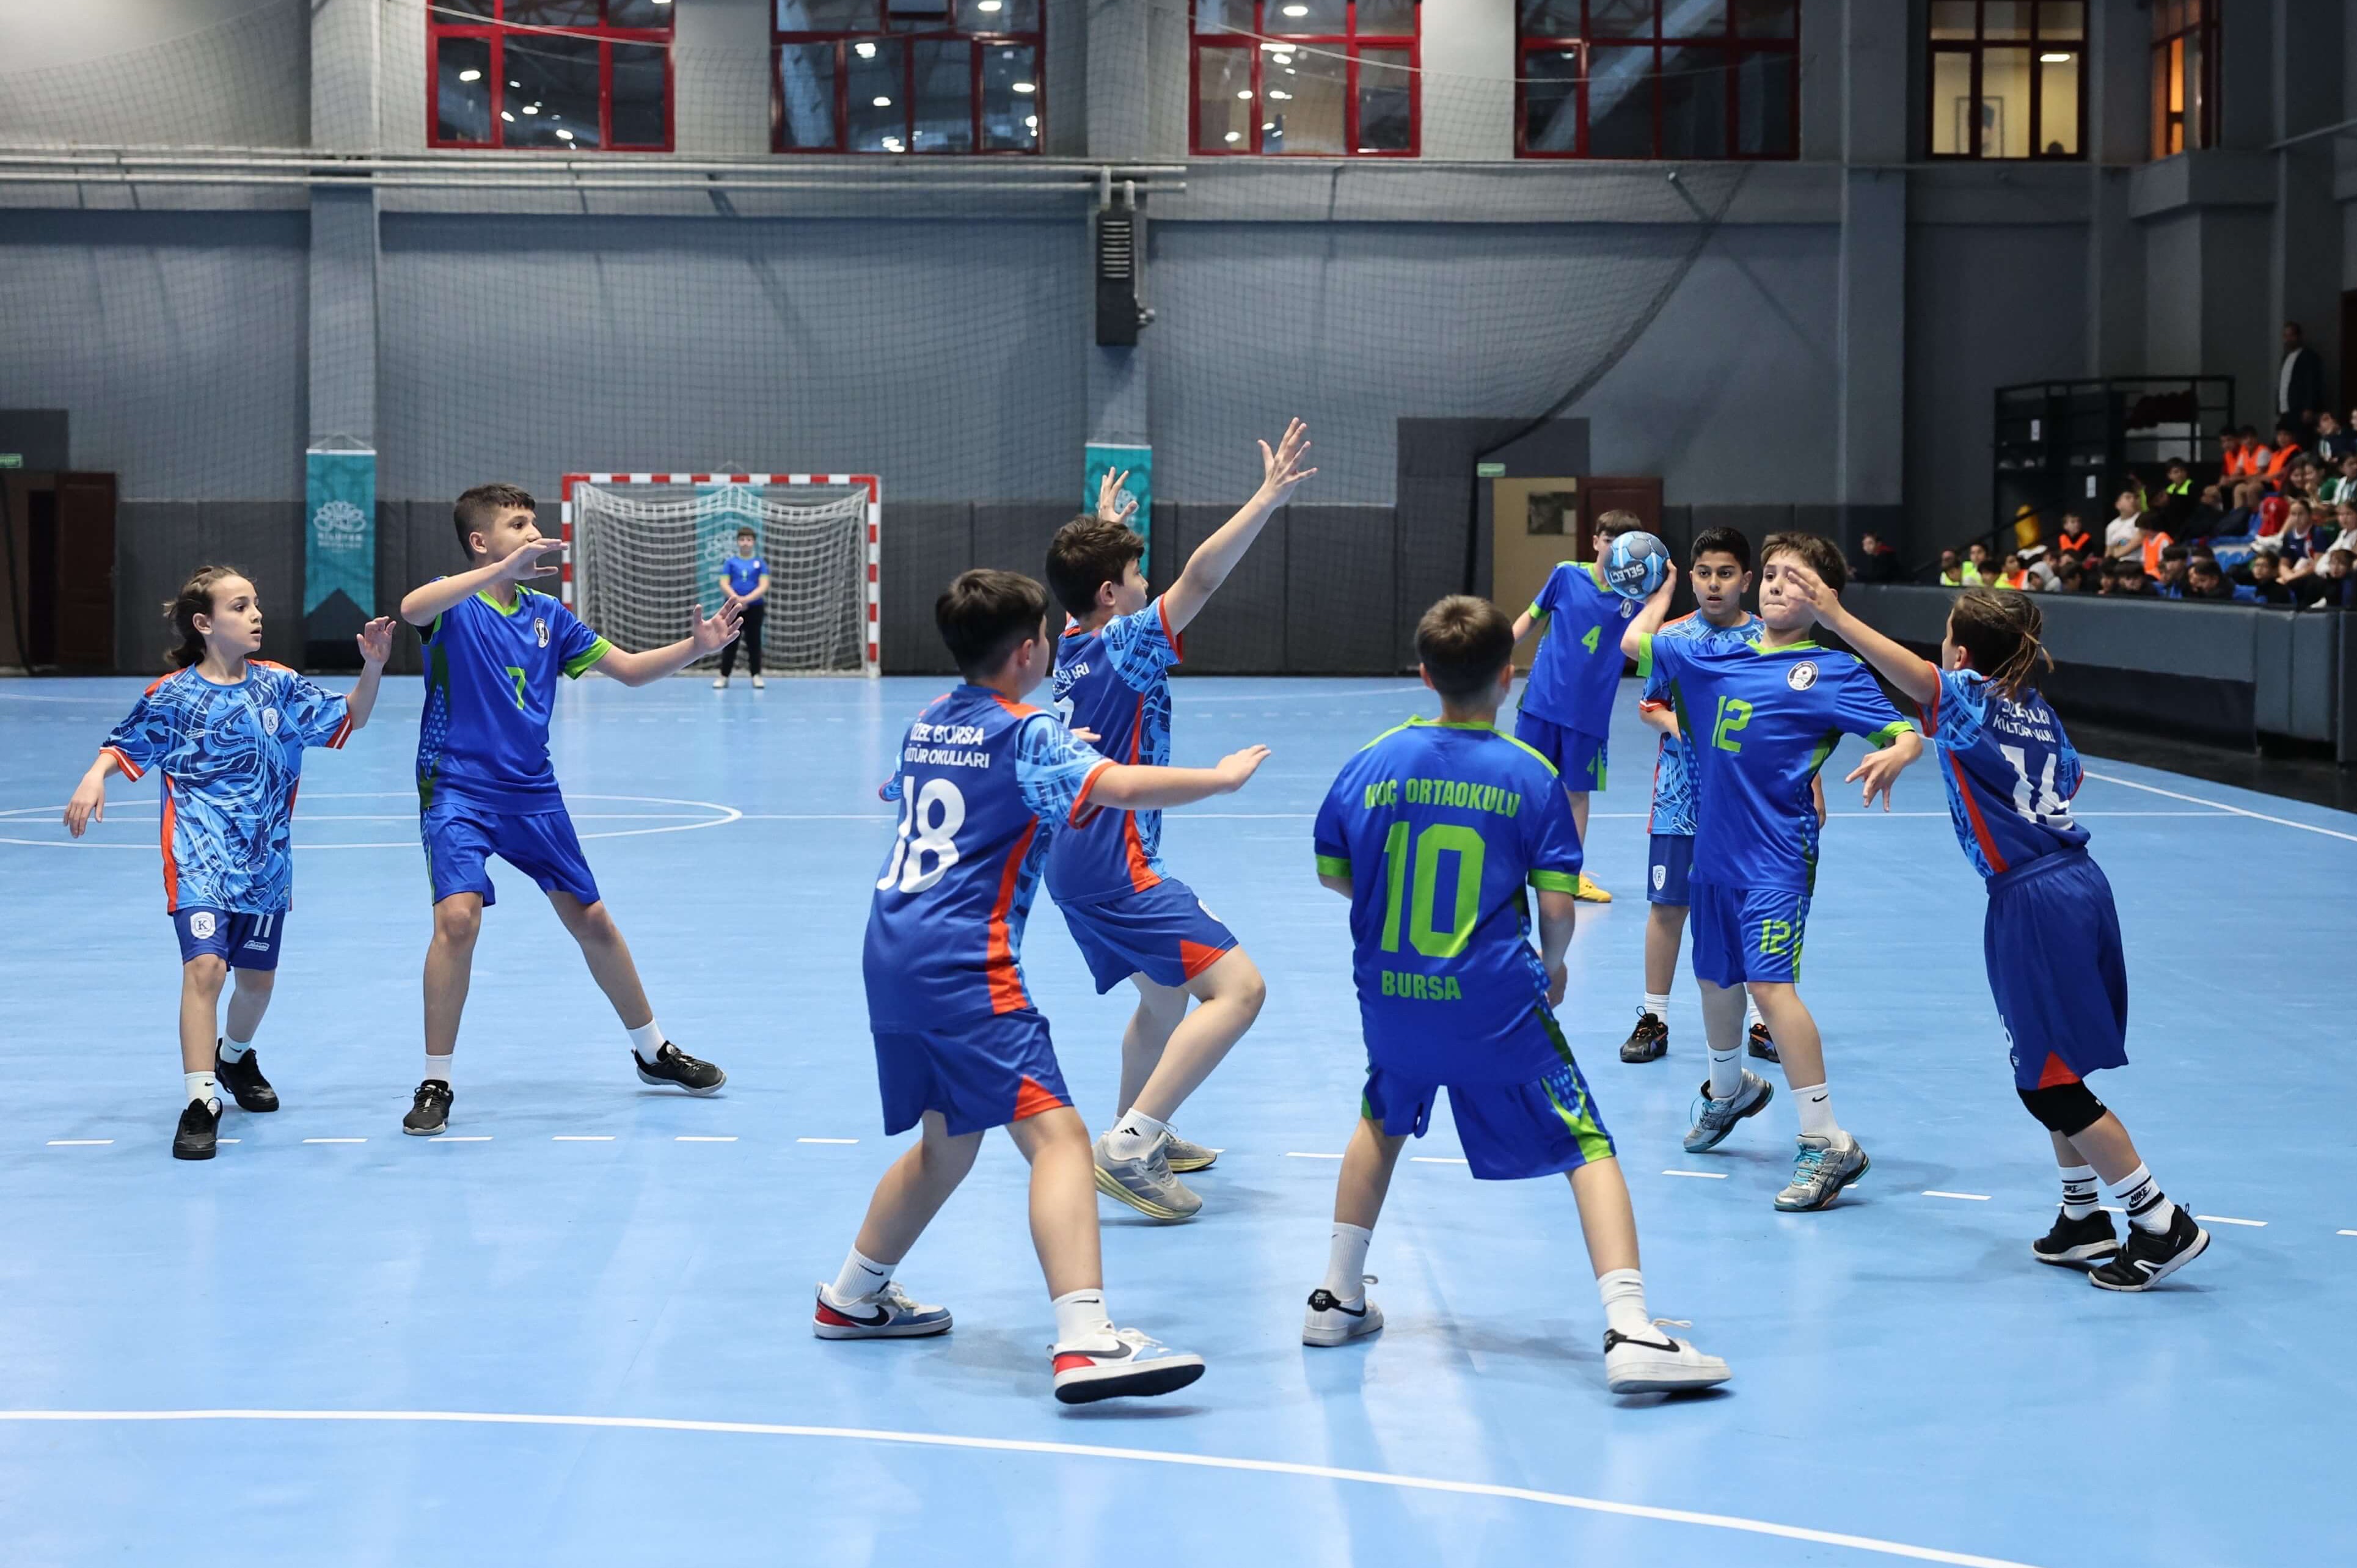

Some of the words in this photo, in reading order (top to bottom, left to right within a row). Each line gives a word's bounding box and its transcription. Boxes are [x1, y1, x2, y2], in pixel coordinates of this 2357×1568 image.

[1581, 625, 1602, 654] 4
[505, 666, 525, 710] 7
[932, 724, 985, 746] BURSA
[1712, 695, 1753, 753] 12
[928, 748, 991, 769] OKULLARI
[1405, 778, 1521, 818] ORTAOKULU
[876, 775, 967, 894] 18
[1380, 821, 1486, 958] 10
[197, 920, 208, 930] K
[253, 913, 274, 938] 11
[1759, 919, 1791, 955] 12
[1381, 970, 1462, 1001] BURSA
[2130, 1186, 2149, 1203] NIKE
